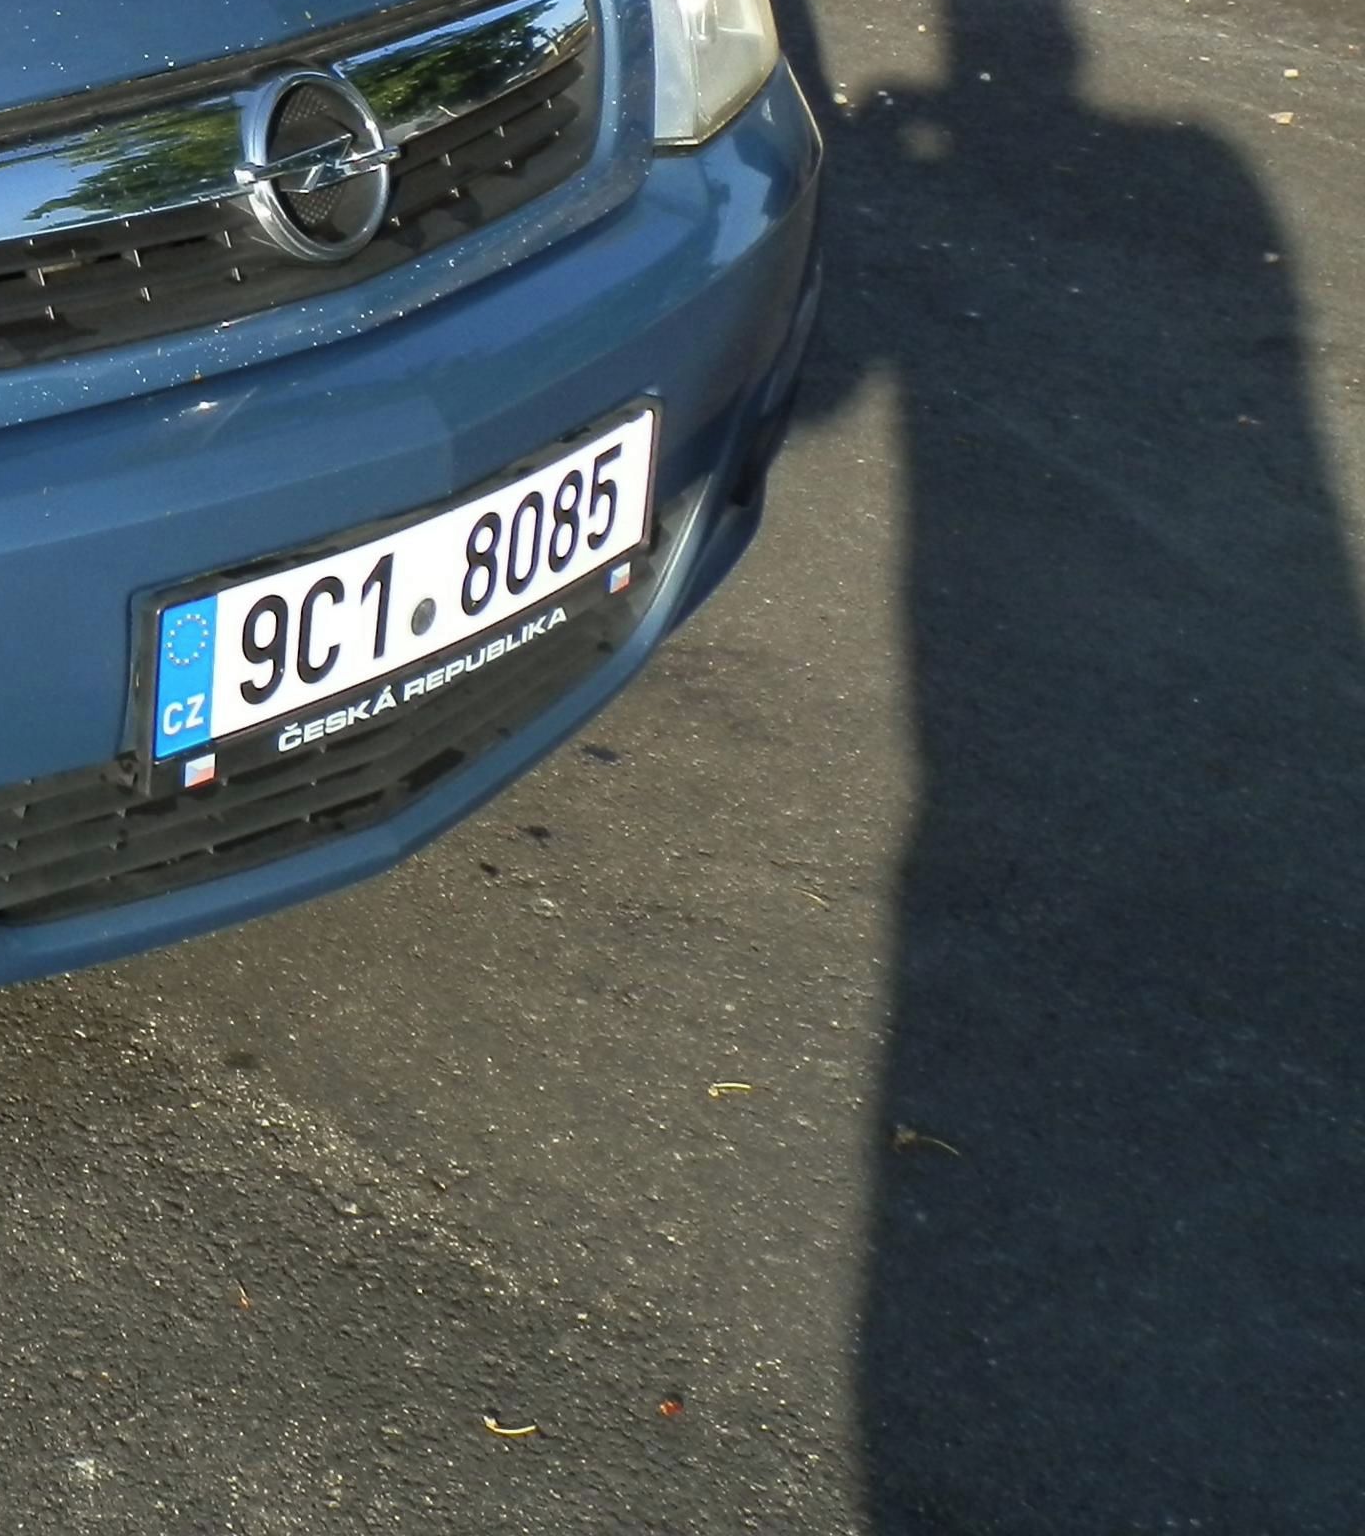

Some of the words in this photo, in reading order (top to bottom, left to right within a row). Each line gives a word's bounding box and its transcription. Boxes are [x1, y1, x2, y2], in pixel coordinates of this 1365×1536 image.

[239, 552, 395, 705] 9C1
[460, 443, 623, 618] 8085
[163, 693, 206, 736] CZ
[277, 685, 397, 753] ČESKÁ
[403, 607, 567, 702] REPUBLIKA
